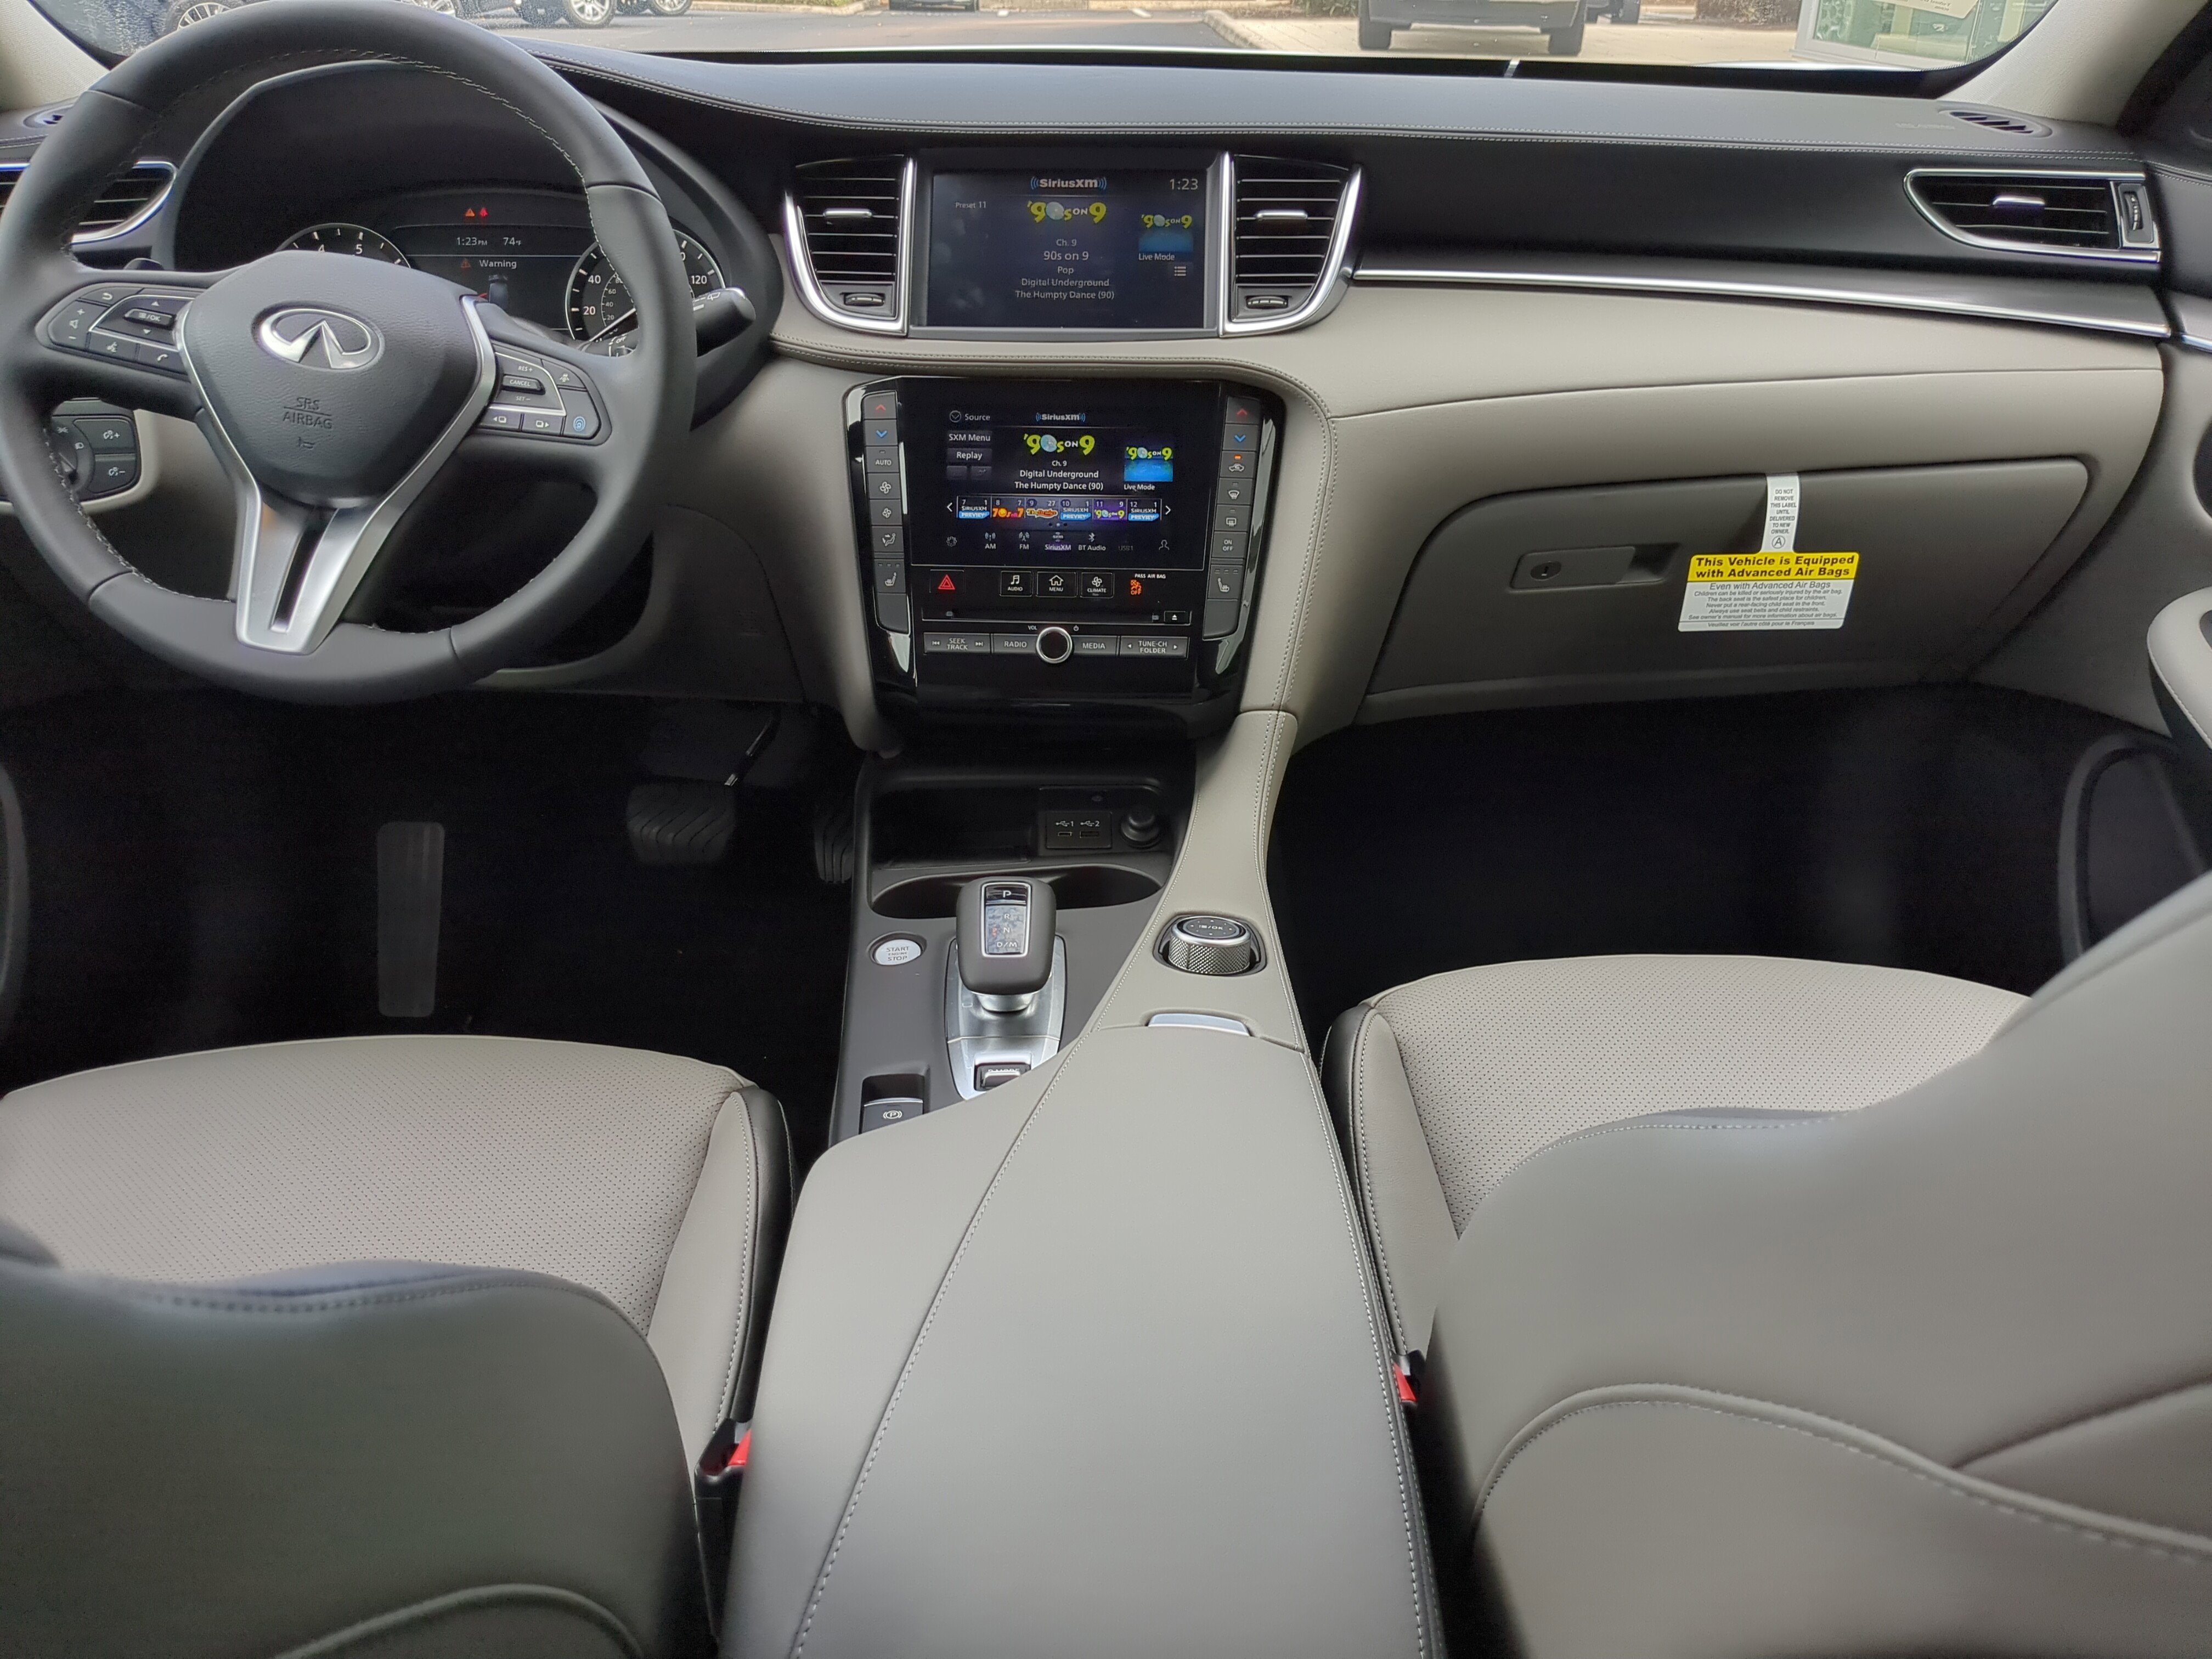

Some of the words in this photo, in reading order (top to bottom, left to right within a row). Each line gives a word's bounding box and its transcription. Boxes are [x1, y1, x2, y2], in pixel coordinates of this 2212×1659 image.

[1170, 178, 1199, 190] 1:23
[1089, 202, 1107, 224] 9
[1181, 215, 1193, 229] 9
[318, 244, 325, 253] 4
[356, 244, 363, 254] 5
[1043, 251, 1062, 261] 90s
[1082, 251, 1089, 261] 9
[479, 259, 517, 269] Warning
[1057, 266, 1074, 275] Pop
[588, 275, 601, 284] 40
[691, 275, 707, 284] 120
[1022, 278, 1049, 287] Digital
[1051, 279, 1109, 288] Underground
[1015, 290, 1031, 298] The
[1033, 291, 1068, 300] Humpty
[1098, 291, 1115, 300] (90)
[583, 306, 596, 315] 20
[283, 411, 332, 429] AIRBAG
[964, 413, 991, 421] Source
[949, 433, 966, 442] SXM
[968, 433, 991, 442] Menu
[1079, 435, 1095, 456] 9
[956, 452, 983, 460] Replay
[1162, 447, 1172, 460] 9
[1019, 470, 1045, 479] Digital
[1047, 471, 1099, 479] Underground
[1030, 482, 1062, 491] Humpty
[1088, 482, 1104, 491] (90)
[1696, 557, 1723, 566] This
[1728, 556, 1775, 566] Vehicle
[1779, 556, 1790, 565] is
[1795, 555, 1854, 566] Equipped
[1696, 569, 1724, 578] with
[1728, 568, 1791, 577] Advanced
[1795, 567, 1814, 576] Air
[1818, 567, 1849, 578] Bags
[1809, 581, 1831, 590] Bags
